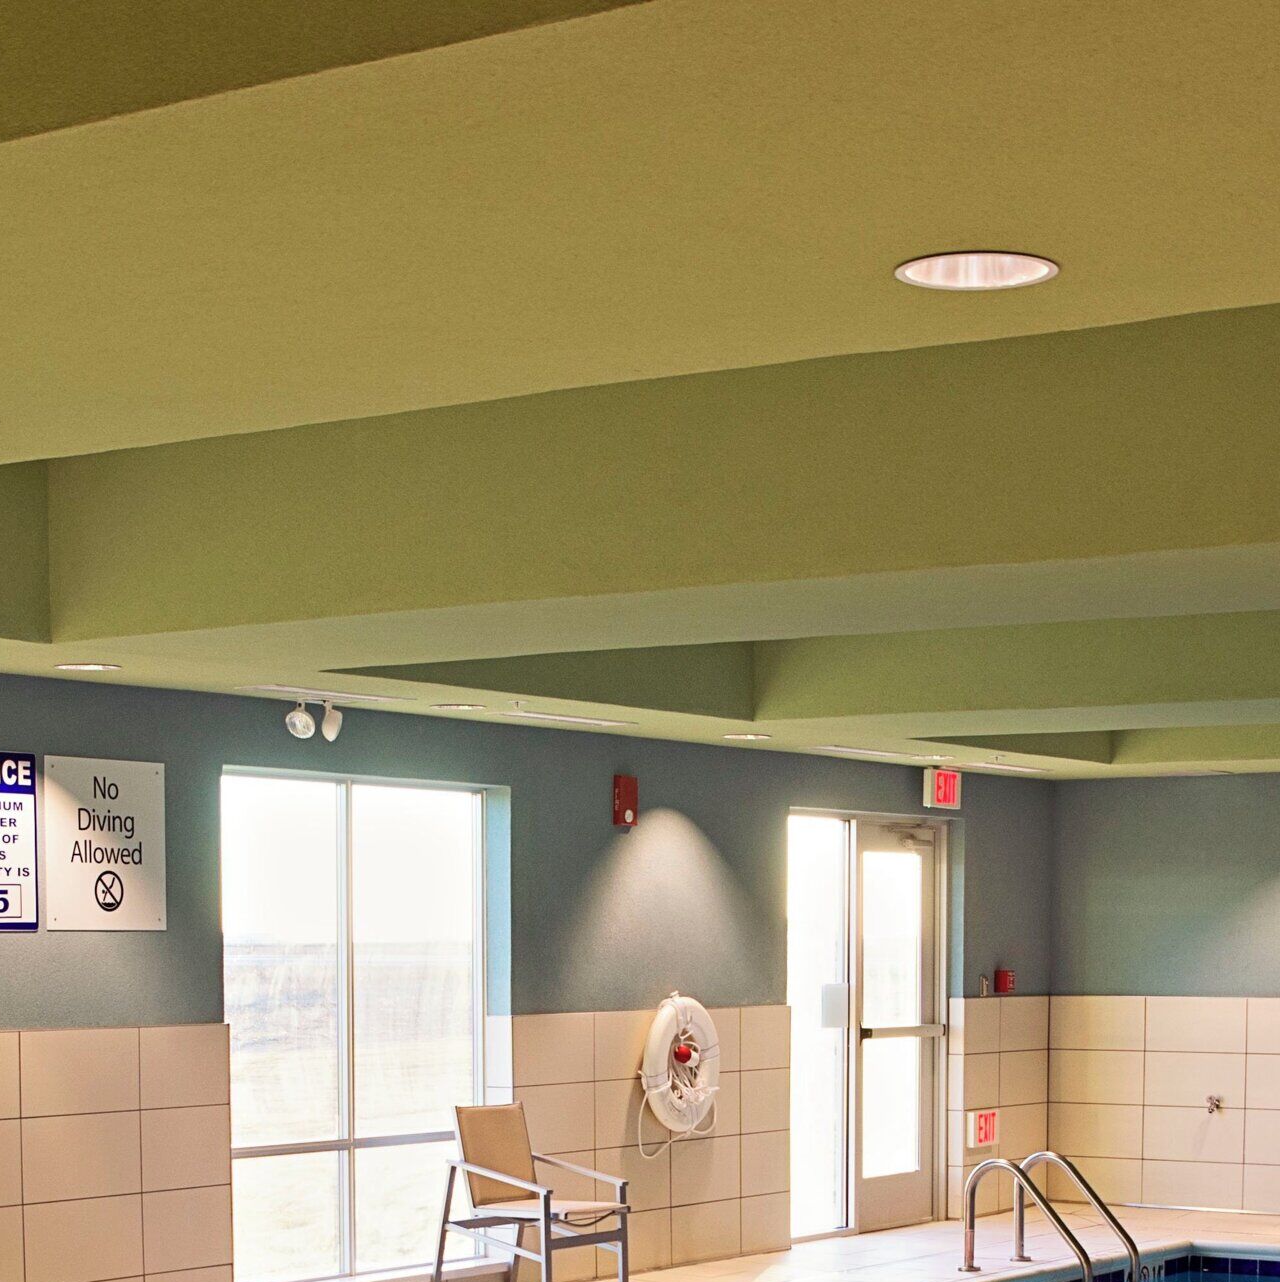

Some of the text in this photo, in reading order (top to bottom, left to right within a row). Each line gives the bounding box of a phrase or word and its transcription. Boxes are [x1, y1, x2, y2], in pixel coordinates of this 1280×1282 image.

[93, 776, 119, 800] No
[936, 771, 957, 803] EXIT
[78, 808, 135, 839] Diving
[2, 834, 19, 844] OF
[71, 839, 143, 865] Allowed
[18, 867, 30, 877] IS
[978, 1111, 996, 1144] EXIT
